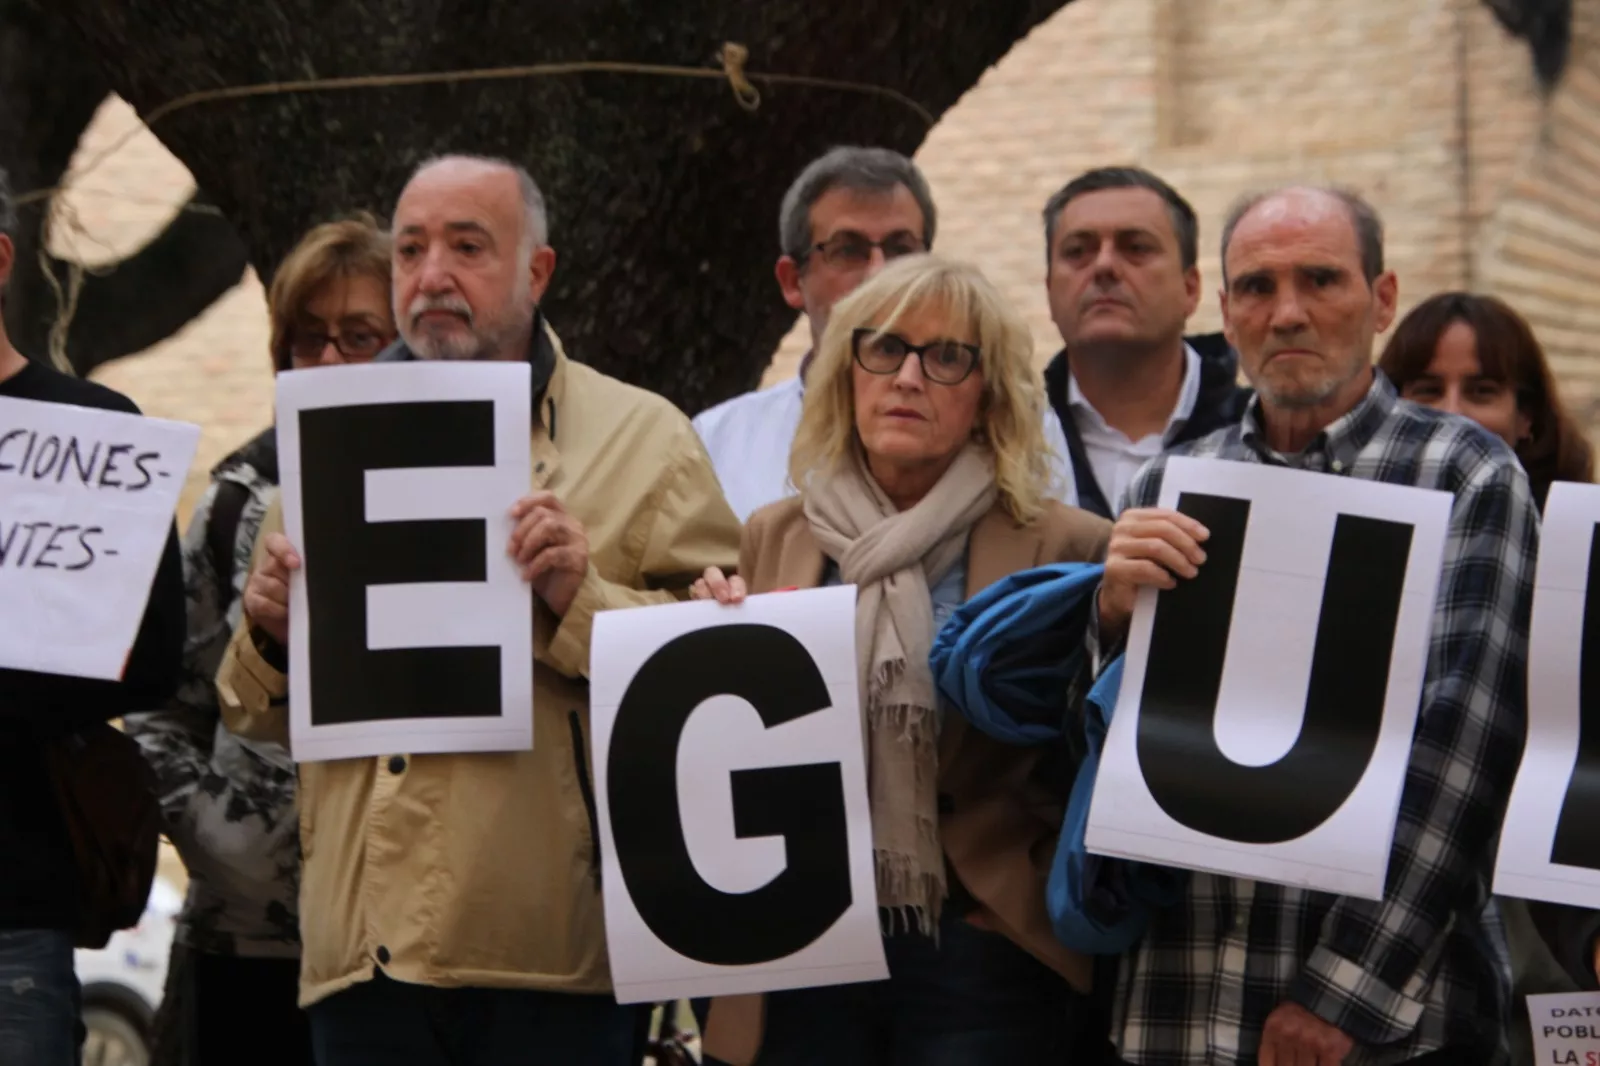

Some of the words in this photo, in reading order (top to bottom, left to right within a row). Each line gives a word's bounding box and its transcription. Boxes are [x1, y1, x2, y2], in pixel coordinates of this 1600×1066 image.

[298, 400, 502, 727] E
[607, 623, 853, 966] G
[1136, 491, 1415, 844] U
[1552, 1048, 1580, 1065] LA
